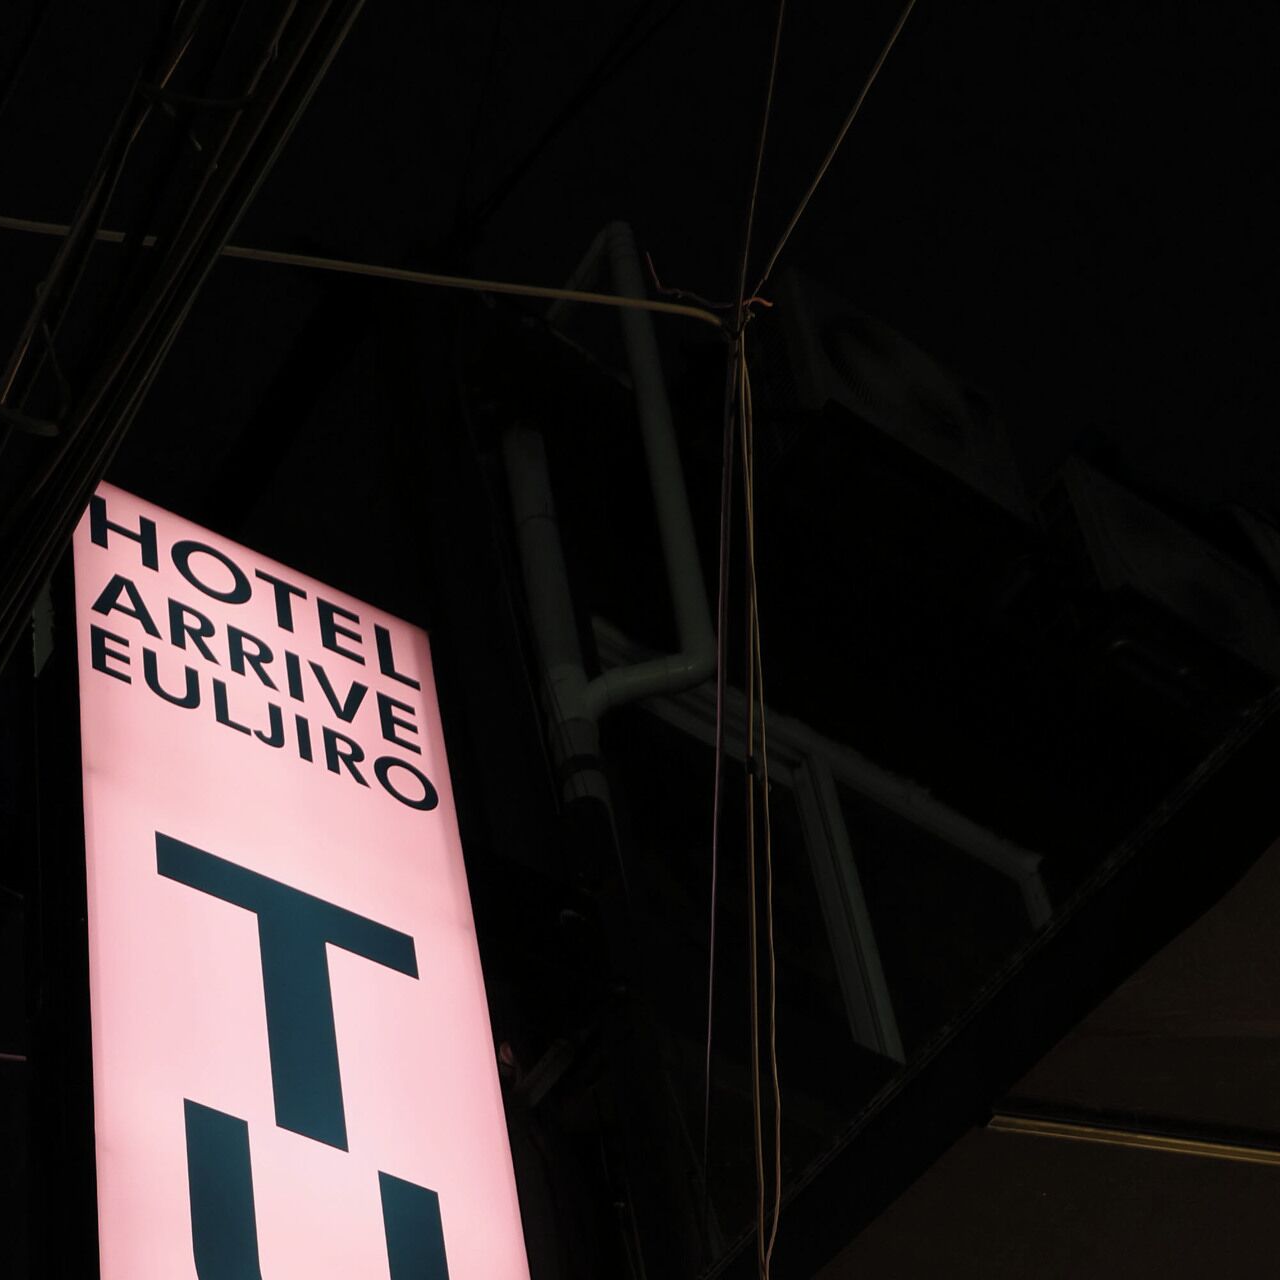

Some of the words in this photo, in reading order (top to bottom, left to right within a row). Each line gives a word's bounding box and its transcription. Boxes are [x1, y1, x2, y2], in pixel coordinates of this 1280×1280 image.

[89, 494, 421, 691] HOTEL
[91, 573, 422, 755] ARRIVE
[90, 624, 439, 811] EULJIRO
